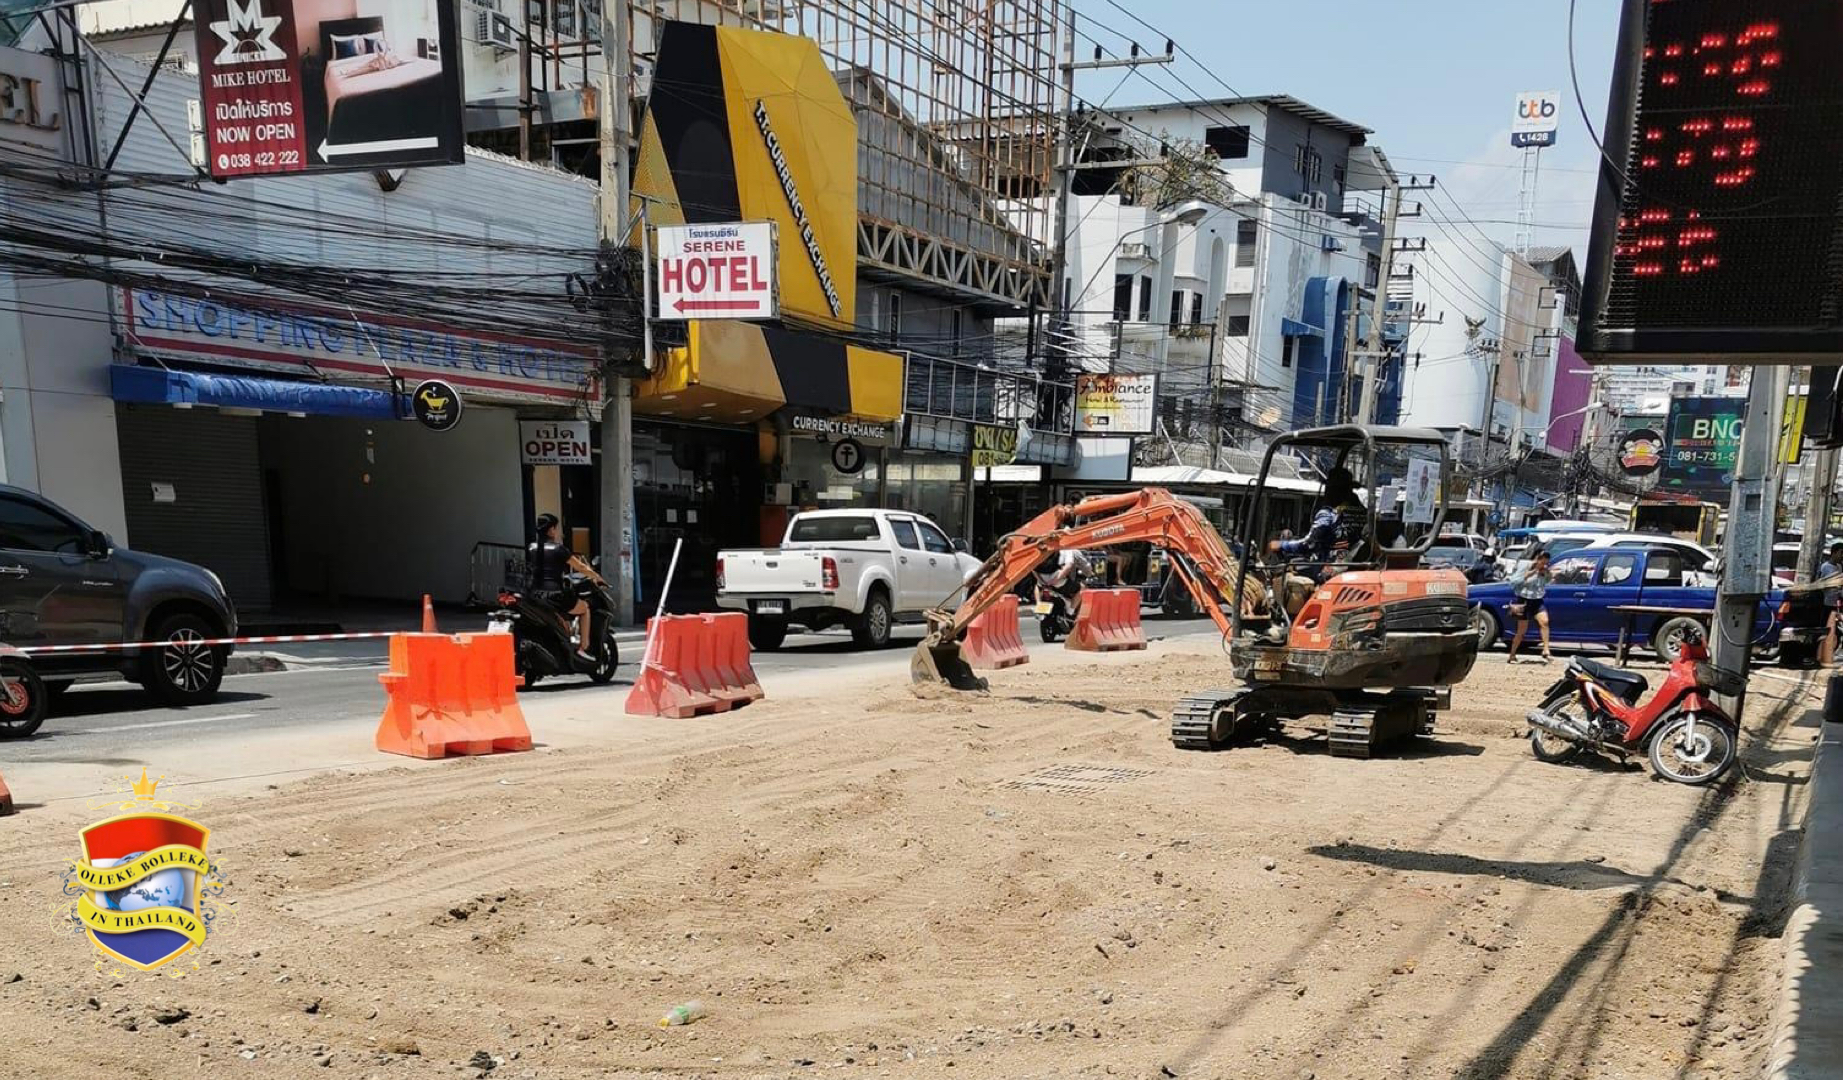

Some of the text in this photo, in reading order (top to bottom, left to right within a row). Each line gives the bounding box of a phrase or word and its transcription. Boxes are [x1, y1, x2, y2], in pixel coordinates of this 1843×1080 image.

[211, 69, 291, 88] MIKE HOTEL
[216, 98, 292, 120] เปิดให้บริการ
[1518, 99, 1555, 118] ttb
[217, 123, 295, 143] NOW OPEN
[230, 151, 299, 168] 038 422 222
[683, 240, 746, 253] SERENE
[662, 256, 767, 294] HOTEL
[801, 224, 842, 318] EXCHANGE
[139, 291, 344, 353] SHOPPING
[1080, 378, 1152, 395] Ambiance
[536, 423, 575, 439] เปิด
[793, 416, 885, 438] CURRENCY EXCHANGE
[525, 441, 587, 457] OPEN
